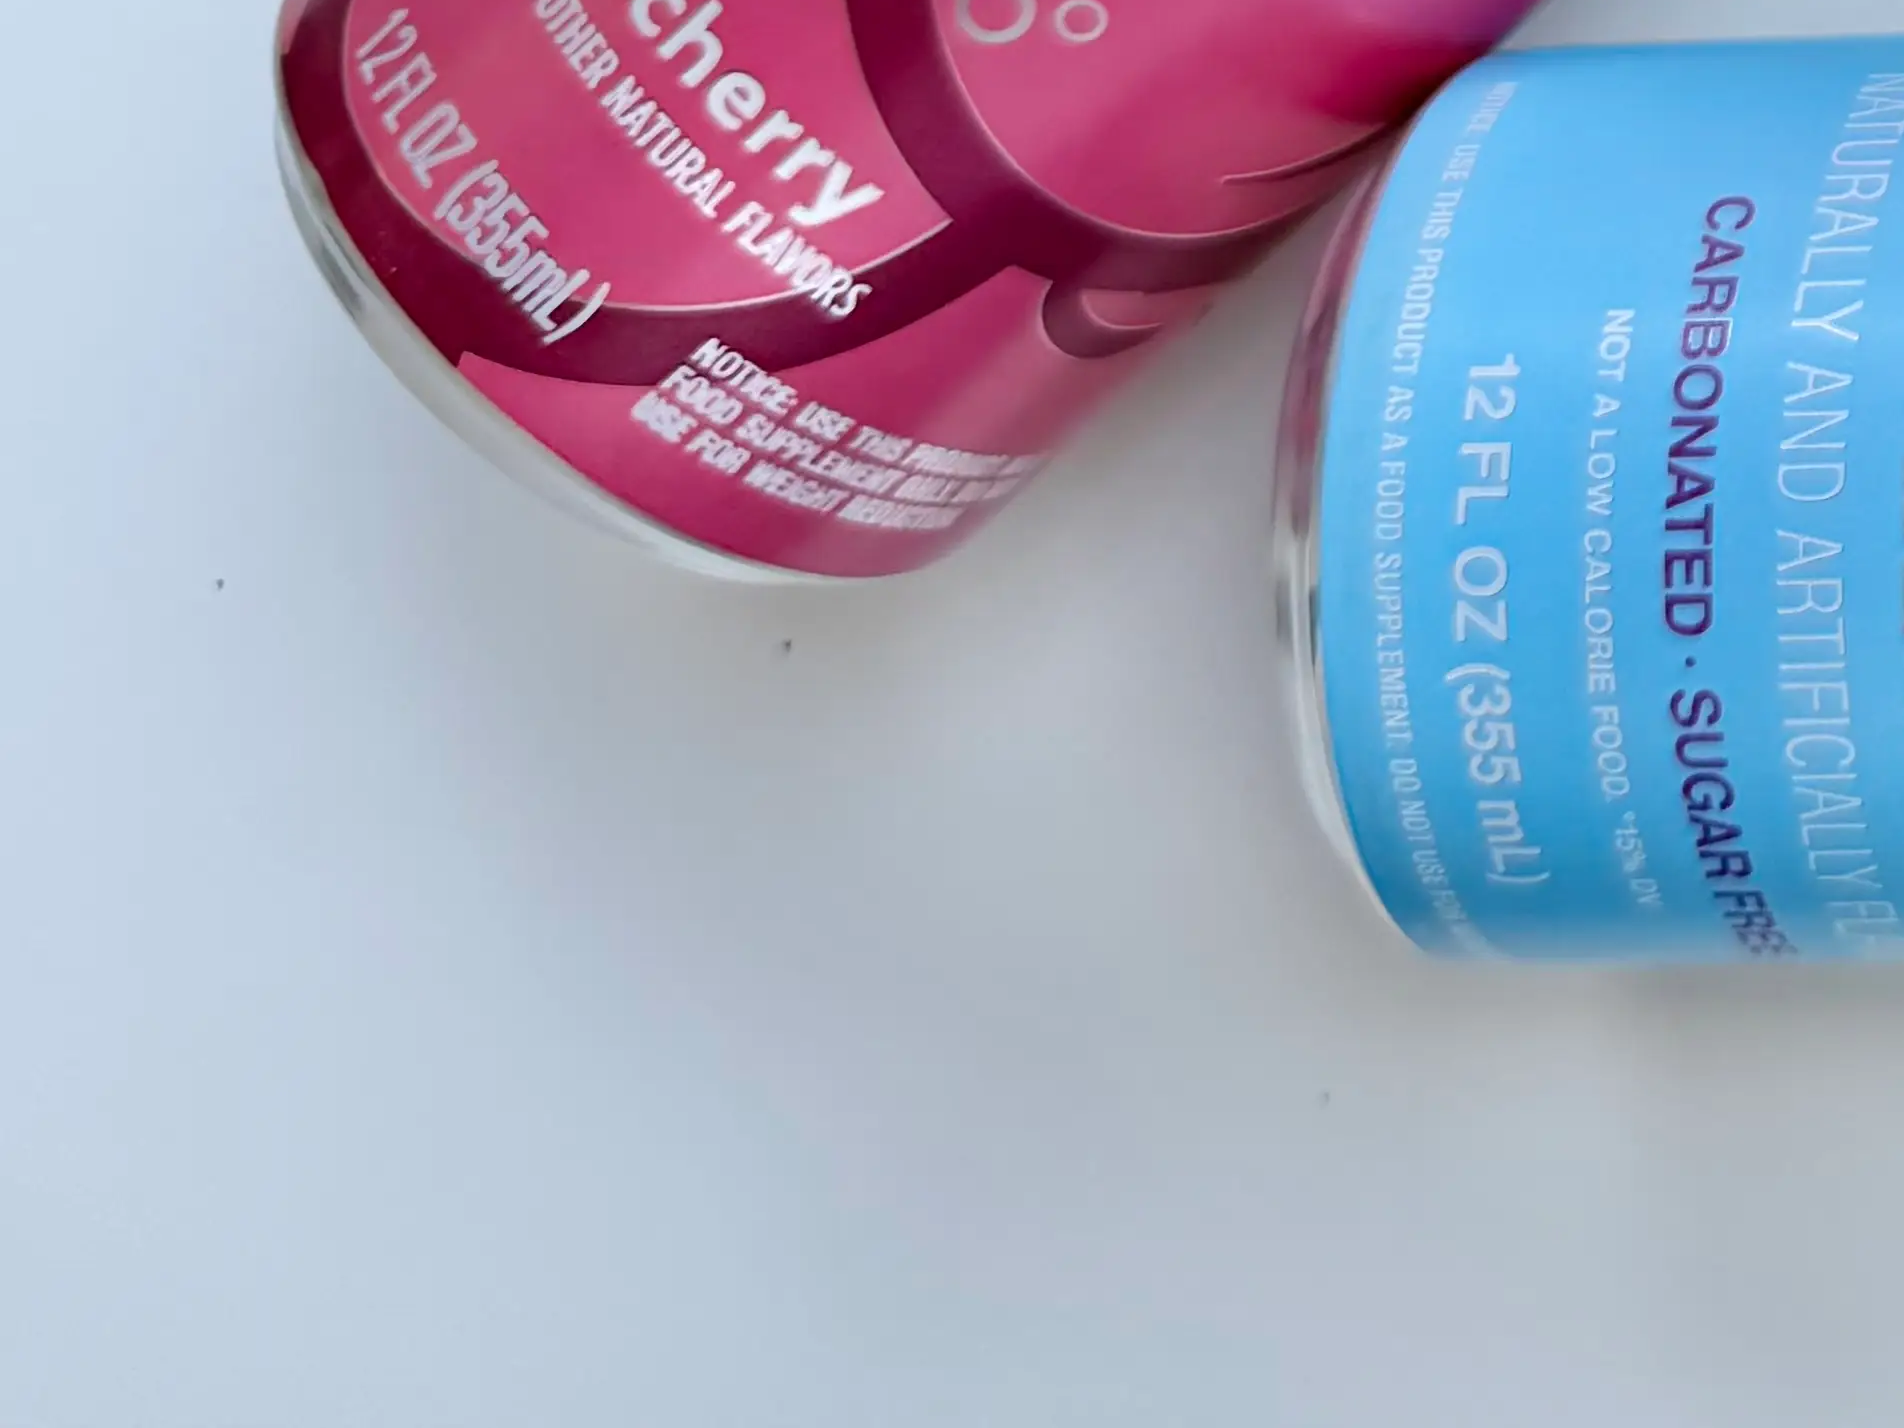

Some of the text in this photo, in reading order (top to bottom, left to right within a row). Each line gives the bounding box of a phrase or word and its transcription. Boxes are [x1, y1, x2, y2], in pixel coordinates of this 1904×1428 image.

[355, 8, 612, 345] 12 FL OZ (355mL)
[600, 74, 737, 218] NATURAL
[721, 199, 872, 318] FLAVORS
[1441, 143, 1482, 183] USE
[1419, 187, 1464, 241] THIS
[1391, 247, 1445, 375] PRODUCT
[1596, 308, 1636, 383] NOT
[659, 364, 744, 425] FOOD
[1384, 385, 1416, 423] AS
[1463, 353, 1522, 422] 12
[1591, 392, 1622, 418] A
[1663, 195, 1756, 637] CARBONATED
[1380, 431, 1411, 453] A
[1585, 428, 1618, 516] LOW
[1777, 360, 1854, 504] AND
[1375, 459, 1407, 542] FOOD
[1456, 442, 1513, 526] FL
[1455, 545, 1509, 643] OZ
[1583, 529, 1618, 695] CALORIE
[1444, 662, 1523, 785] (355
[1776, 528, 1884, 889] ARTIFICIALLY
[1388, 757, 1423, 794] DO
[1669, 688, 1754, 880] SUGAR
[1400, 799, 1434, 843] NOT
[1477, 799, 1552, 884] mL)
